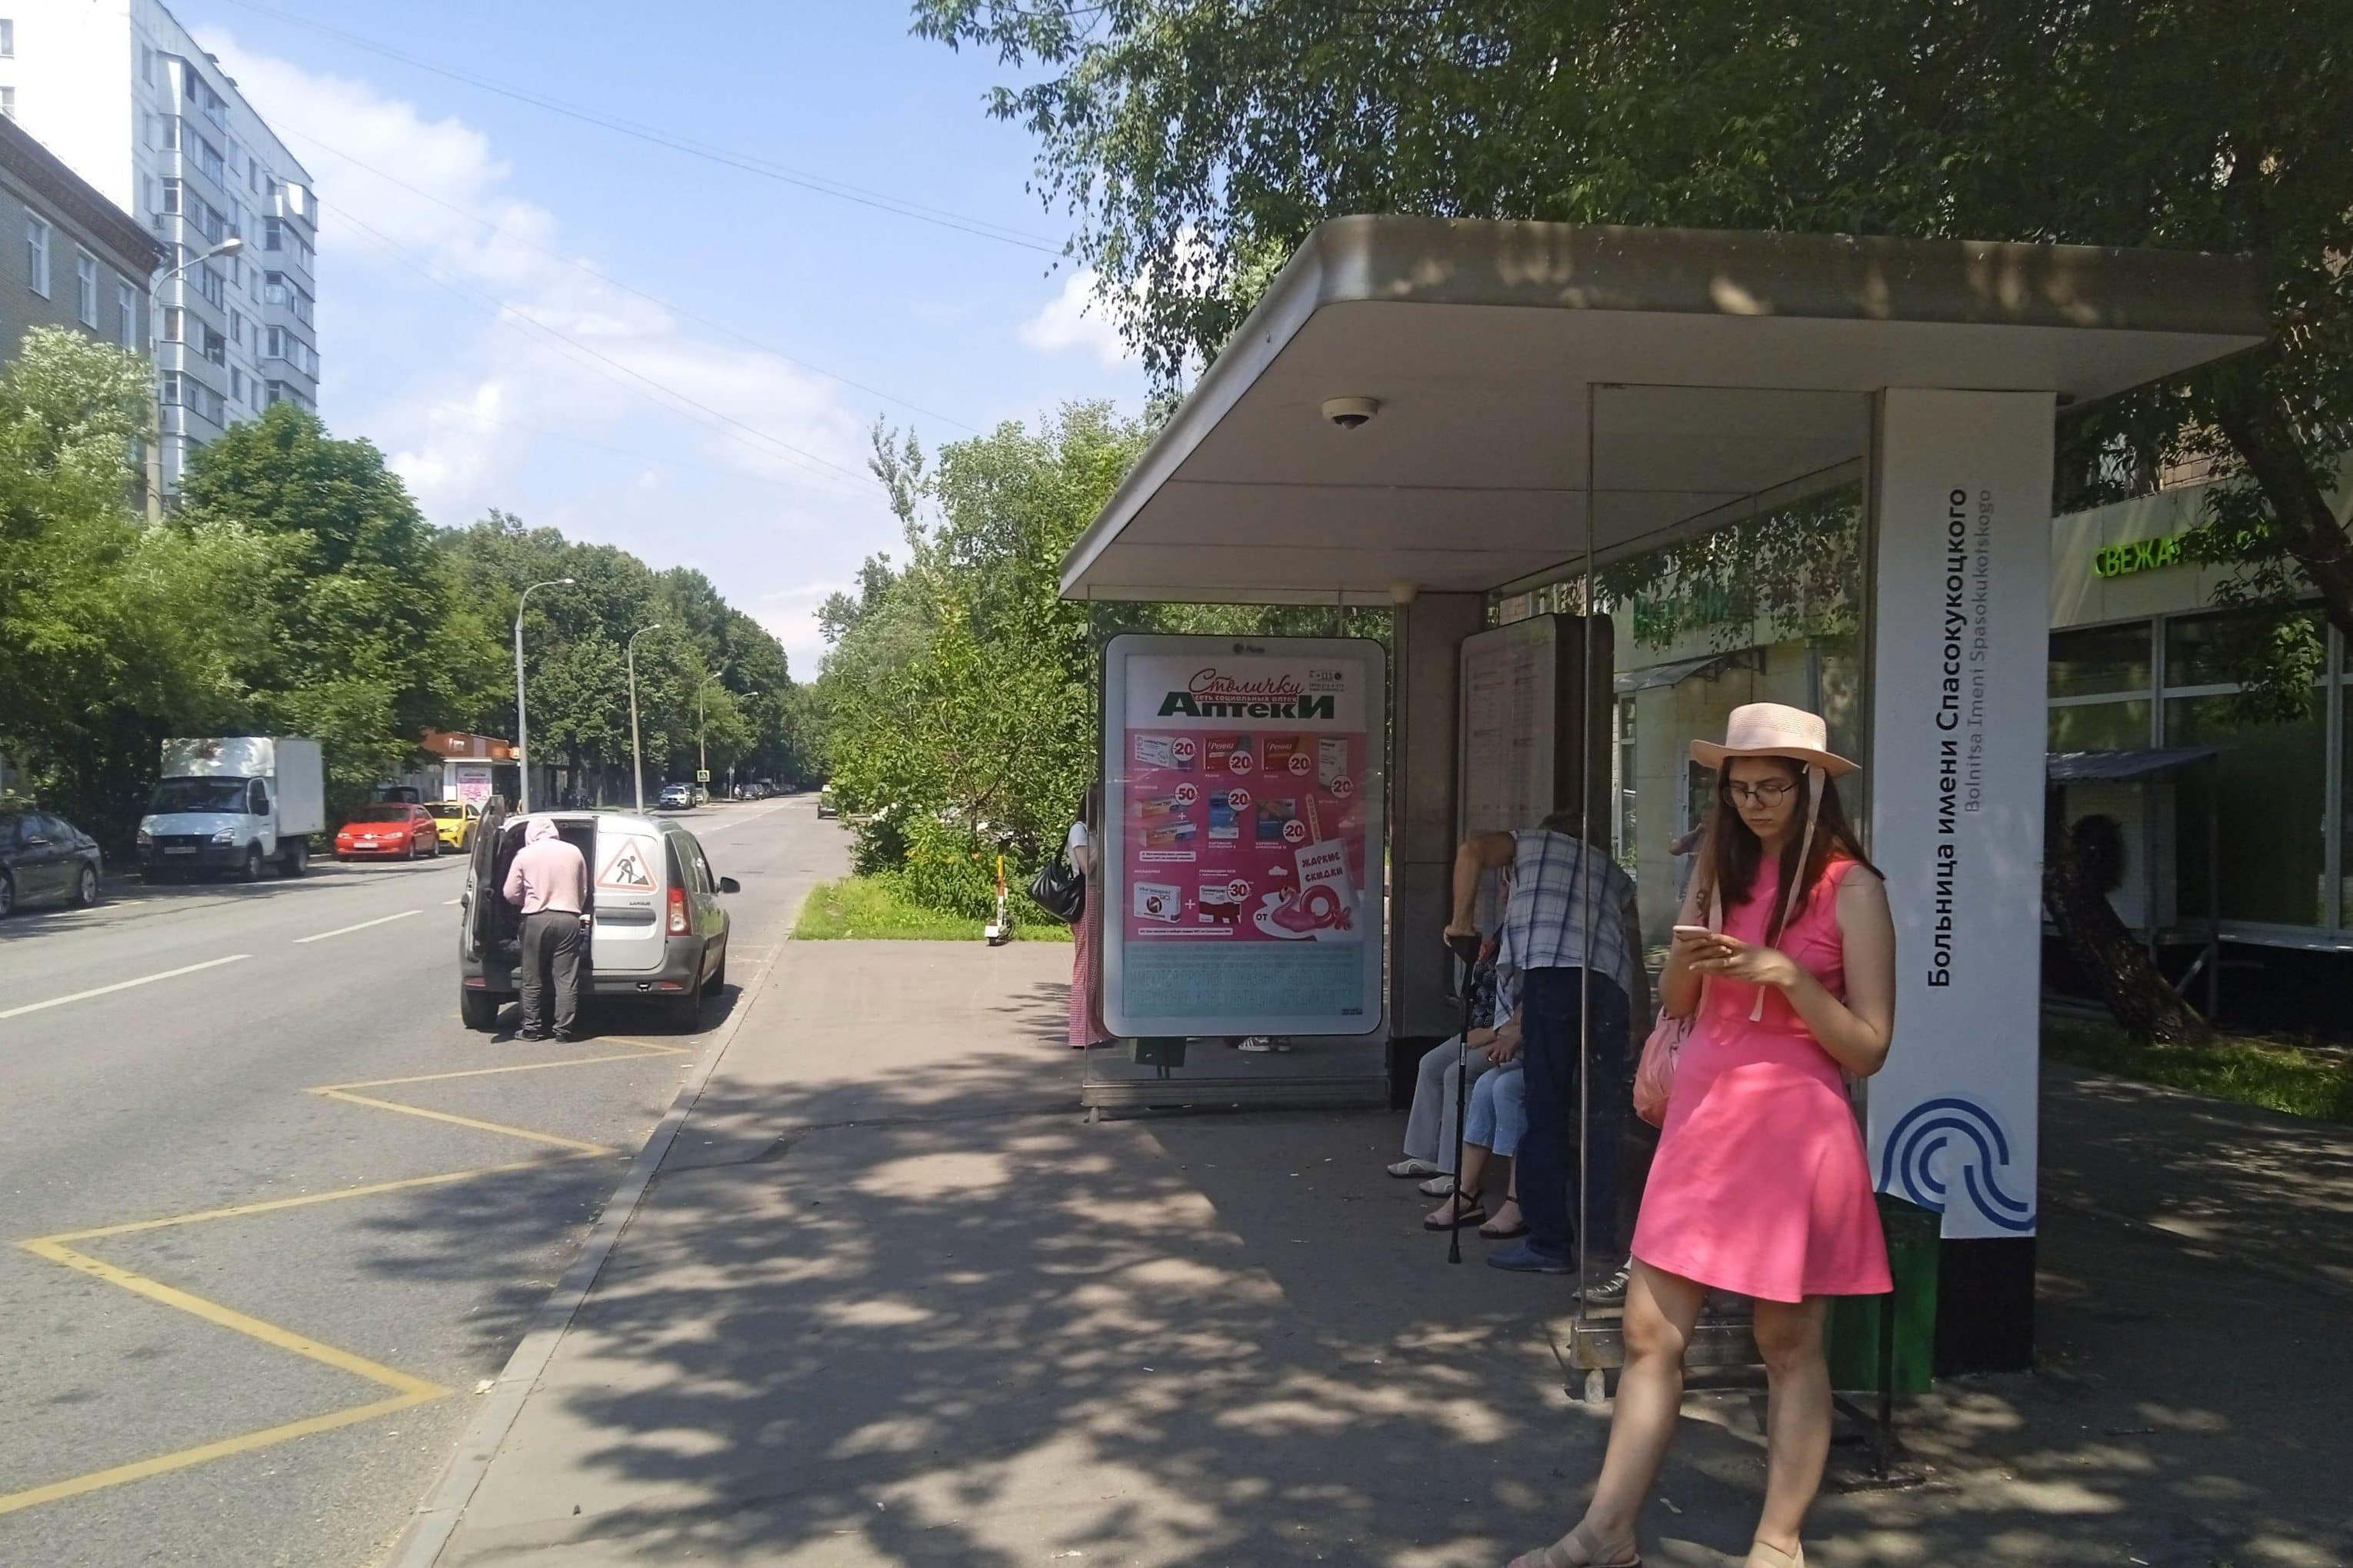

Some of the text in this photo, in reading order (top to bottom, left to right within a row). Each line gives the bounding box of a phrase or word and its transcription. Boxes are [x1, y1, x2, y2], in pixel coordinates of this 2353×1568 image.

[2095, 537, 2181, 578] СВЕЖА
[1964, 489, 1995, 813] Bolnitsa Imeni Spasokukotskogo
[1188, 667, 1305, 695] Столички
[1928, 488, 1968, 987] Больница имени Спасокукоцкого
[1301, 851, 1341, 868] ЖАРКИЕ
[1305, 867, 1343, 883] СКИДКИ
